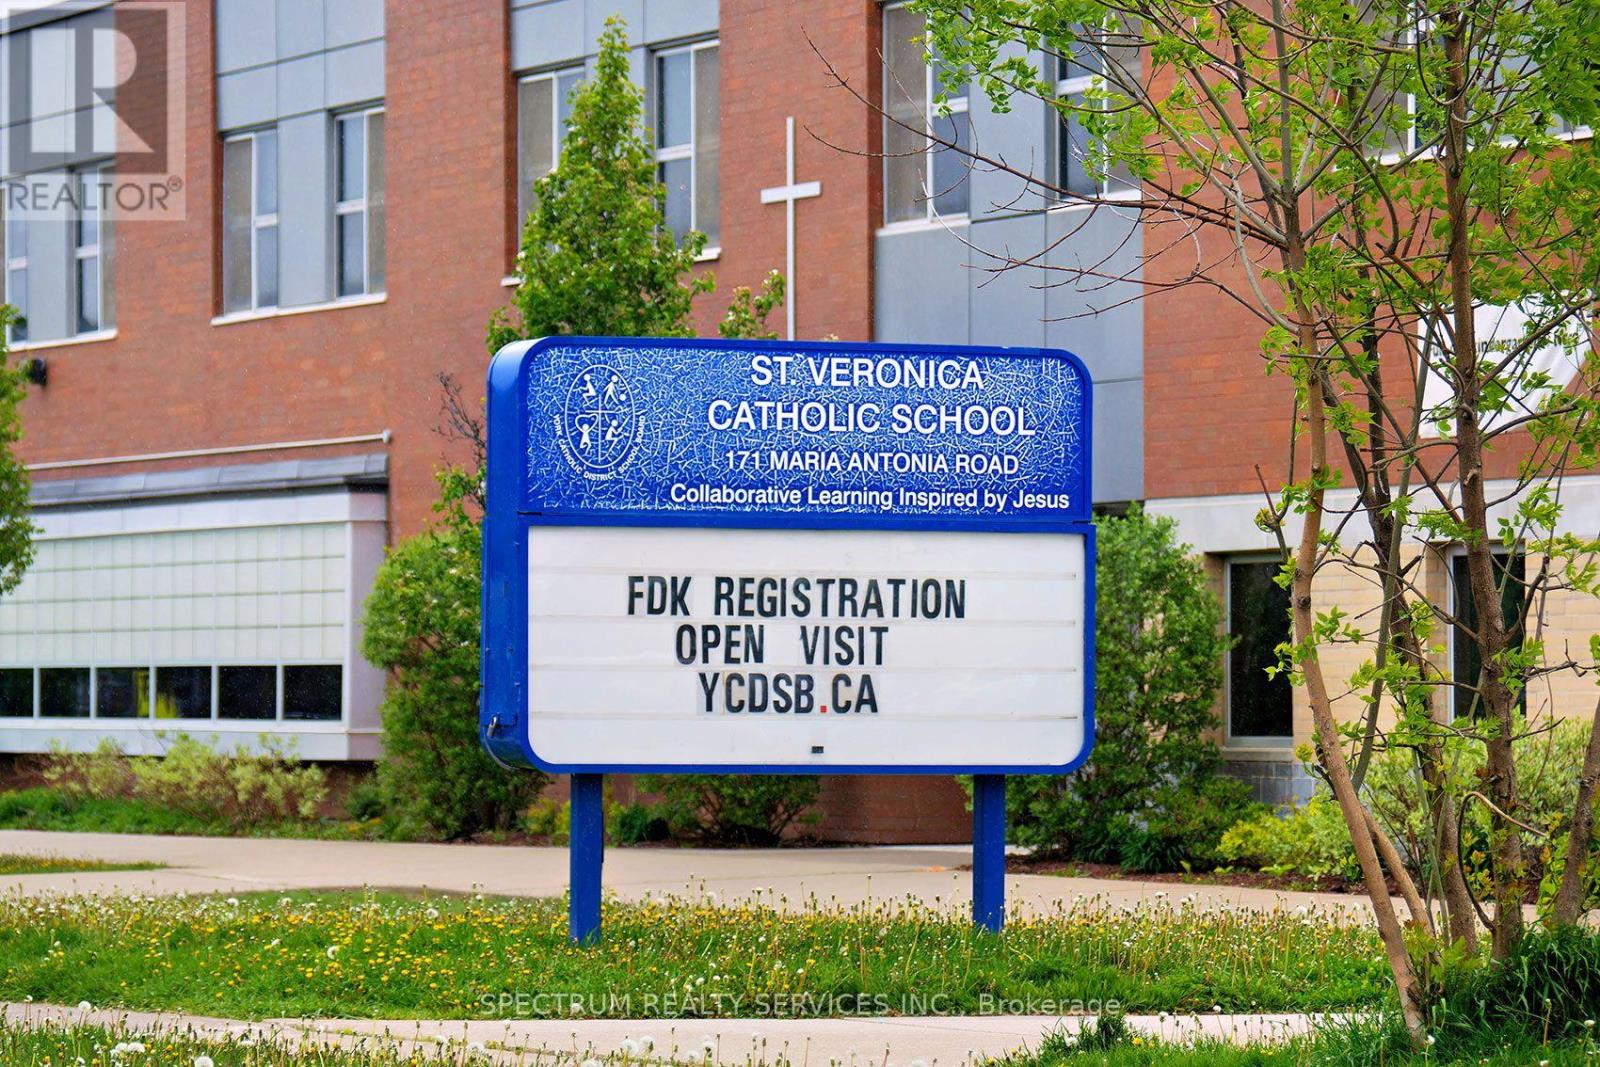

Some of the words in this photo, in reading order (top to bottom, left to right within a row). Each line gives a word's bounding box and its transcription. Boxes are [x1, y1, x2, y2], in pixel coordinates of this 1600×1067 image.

[751, 355, 797, 386] ST.
[808, 357, 984, 389] VERONICA
[708, 399, 881, 433] CATHOLIC
[891, 403, 1036, 435] SCHOOL
[553, 414, 563, 436] YORK
[558, 438, 583, 474] CATHOLIC
[583, 471, 617, 481] DISTRICT
[618, 446, 640, 474] SCHOOL
[636, 415, 646, 443] BOARD
[725, 450, 760, 470] 171
[770, 450, 842, 471] MARIA
[847, 452, 949, 473] ANTONIA
[955, 454, 1019, 475] ROAD
[670, 482, 801, 504] Collaborative
[807, 486, 893, 511] Learning
[900, 487, 977, 510] Inspired
[984, 489, 1008, 513] by
[1012, 489, 1070, 509] Jesus
[627, 576, 692, 616] FDK
[714, 576, 966, 618] REGISTRATION
[675, 624, 765, 665] OPEN
[800, 625, 889, 666] VISIT
[698, 672, 879, 714] YCDSB.CA
